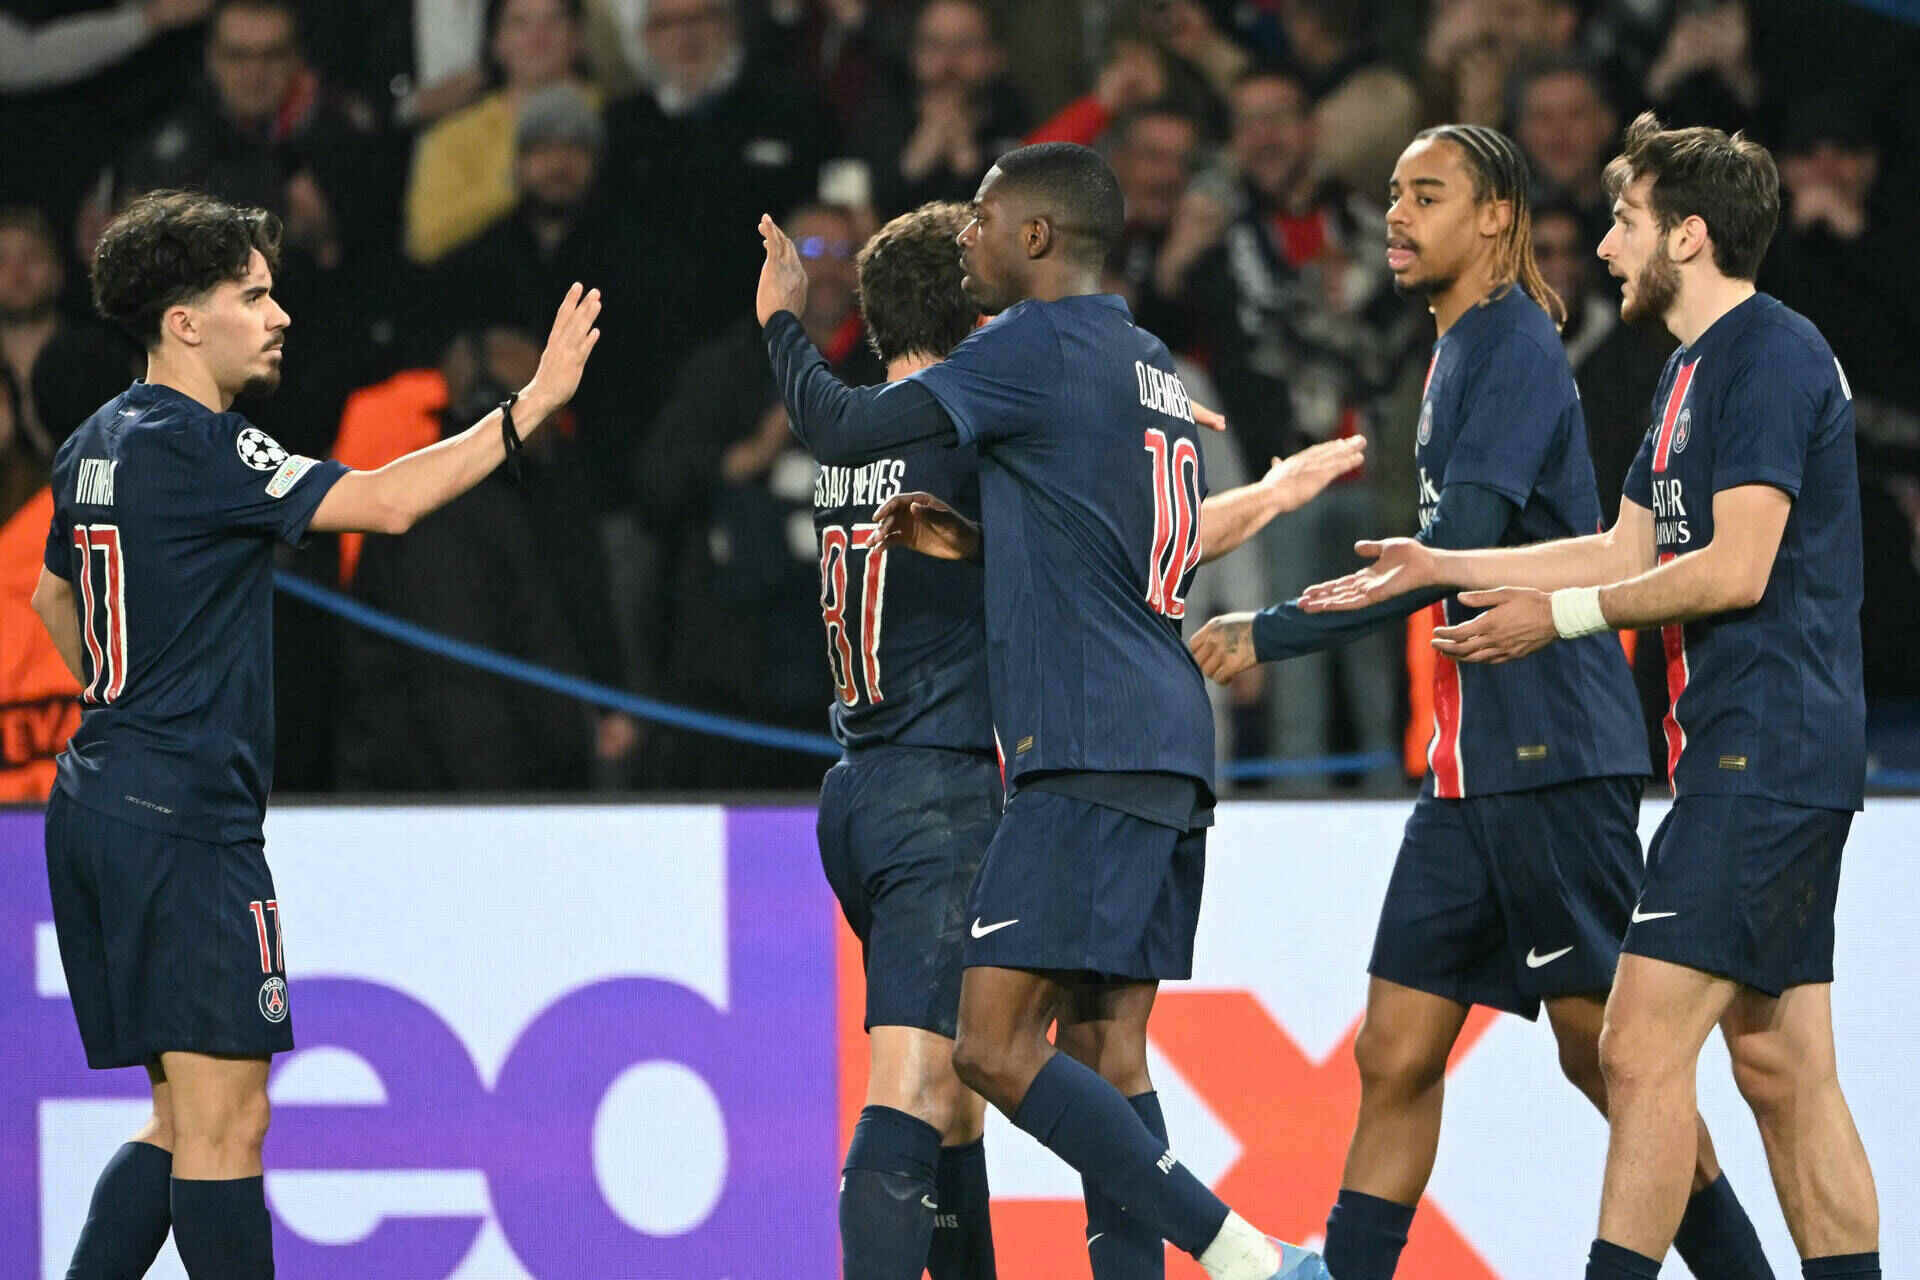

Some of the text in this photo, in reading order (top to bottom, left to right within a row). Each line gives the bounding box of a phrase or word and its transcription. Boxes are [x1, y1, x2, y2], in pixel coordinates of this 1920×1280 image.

[853, 459, 906, 506] NEVES
[1144, 427, 1202, 619] 10
[73, 523, 128, 704] 17
[820, 523, 888, 707] 87
[249, 900, 284, 974] 17
